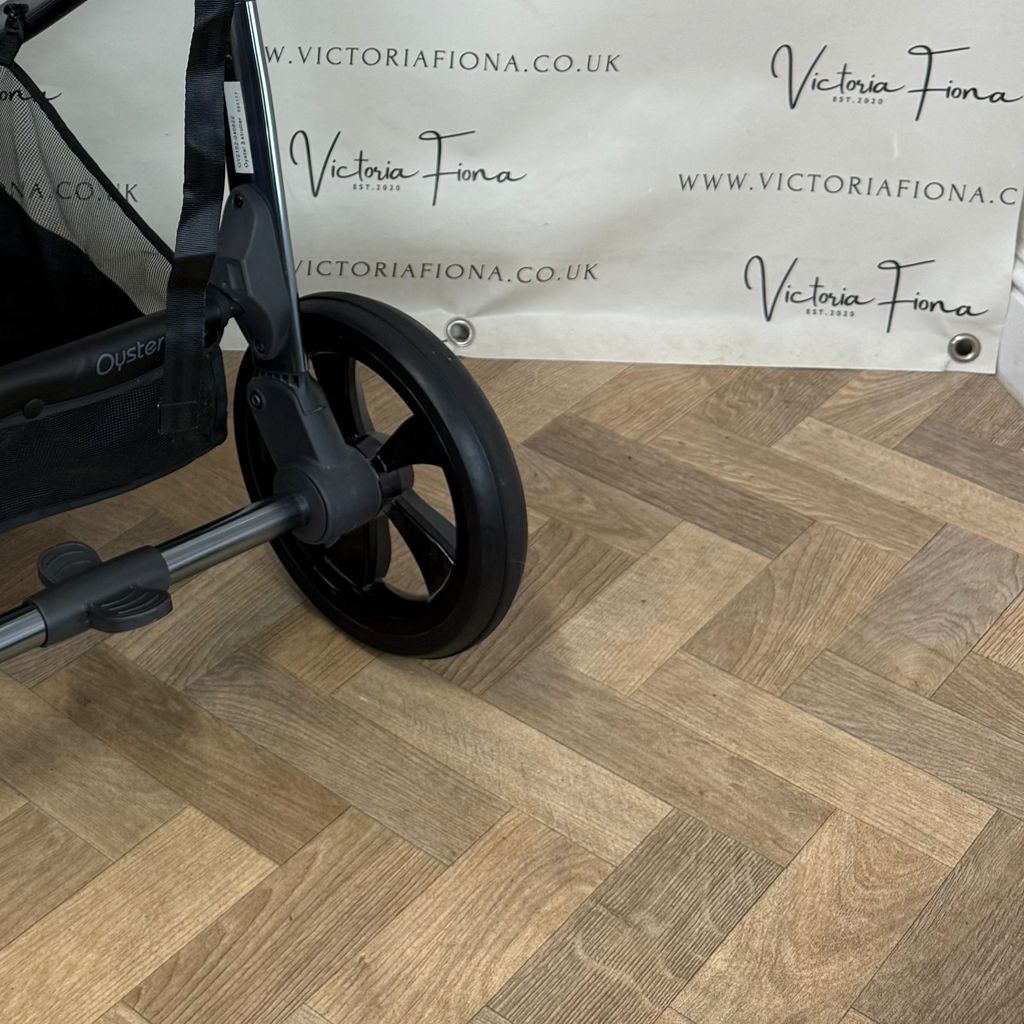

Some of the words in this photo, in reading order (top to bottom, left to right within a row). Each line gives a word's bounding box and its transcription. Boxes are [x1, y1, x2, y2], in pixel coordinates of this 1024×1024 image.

[265, 45, 621, 74] W.VICTORIAFIONA.CO.UK
[771, 44, 906, 110] Victoria
[907, 45, 1023, 122] Fiona
[832, 96, 884, 106] EST.2020
[289, 130, 420, 198] Victoria
[418, 130, 528, 207] Fiona
[352, 183, 401, 192] EST.2020
[678, 172, 1018, 206] WWW.VICTORIAFIONA.C
[744, 255, 875, 322] Victoria
[877, 259, 989, 334] Fiona
[805, 308, 856, 318] EST.2020
[96, 335, 165, 376] Oyster
